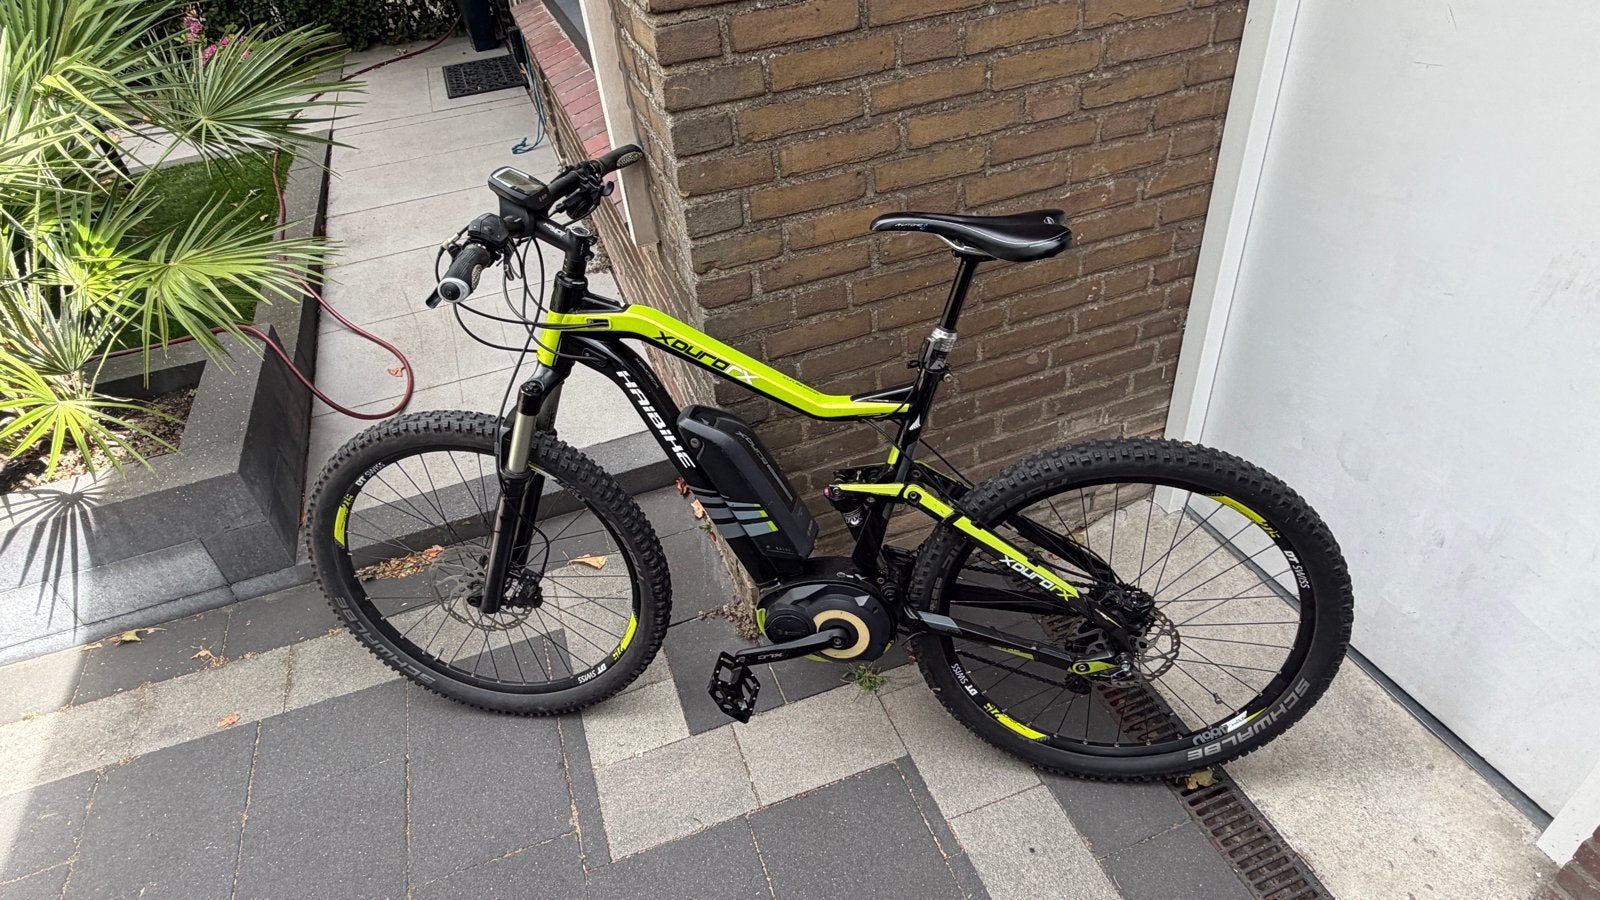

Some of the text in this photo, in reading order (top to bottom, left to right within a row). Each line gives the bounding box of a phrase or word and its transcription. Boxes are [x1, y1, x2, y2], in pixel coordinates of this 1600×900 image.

[1292, 565, 1310, 589] SWISS
[578, 669, 597, 684] SWISS
[951, 663, 969, 685] SWISS
[1187, 677, 1311, 761] SCHWALBE
